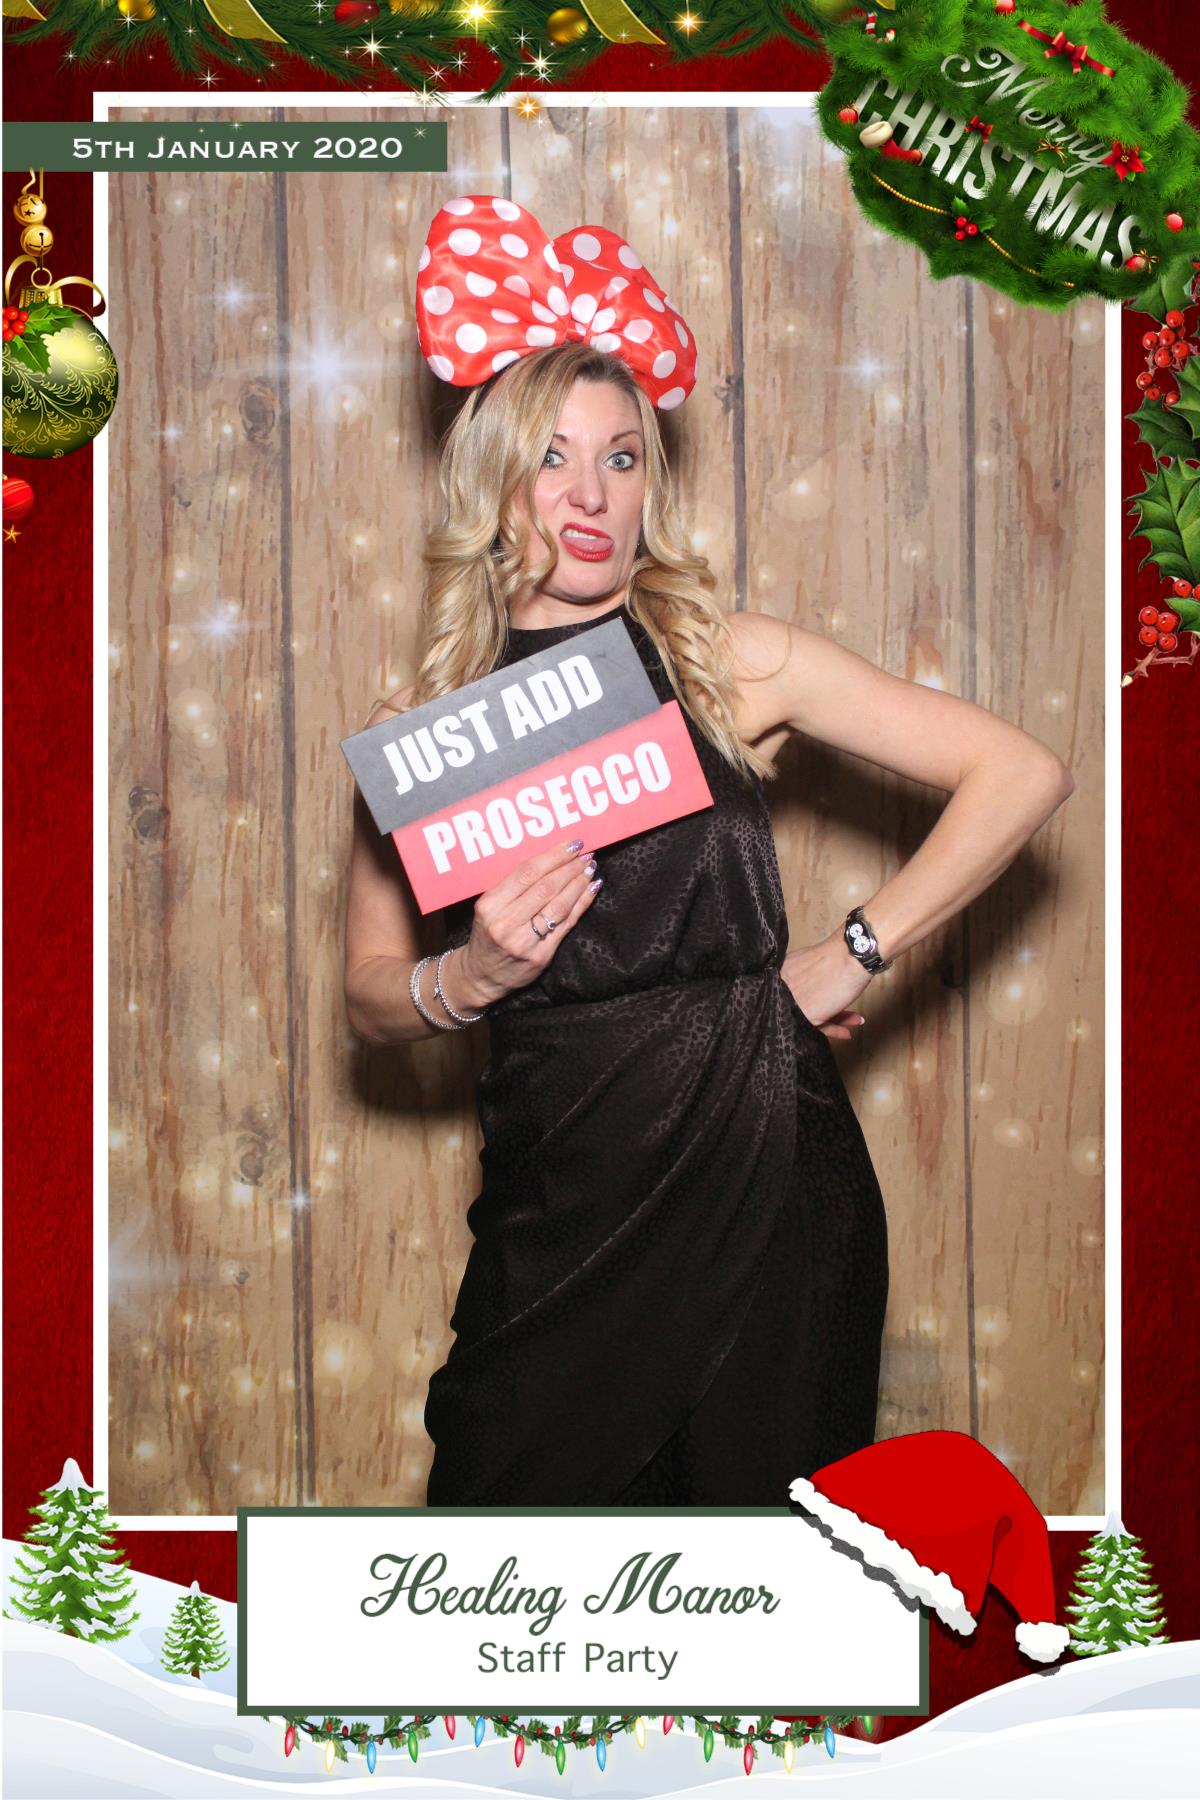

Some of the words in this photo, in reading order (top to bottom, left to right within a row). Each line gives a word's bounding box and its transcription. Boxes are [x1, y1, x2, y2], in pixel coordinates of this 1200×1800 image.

[381, 699, 498, 796] JUST
[500, 654, 604, 740] ADD
[422, 741, 672, 875] PROSECCO
